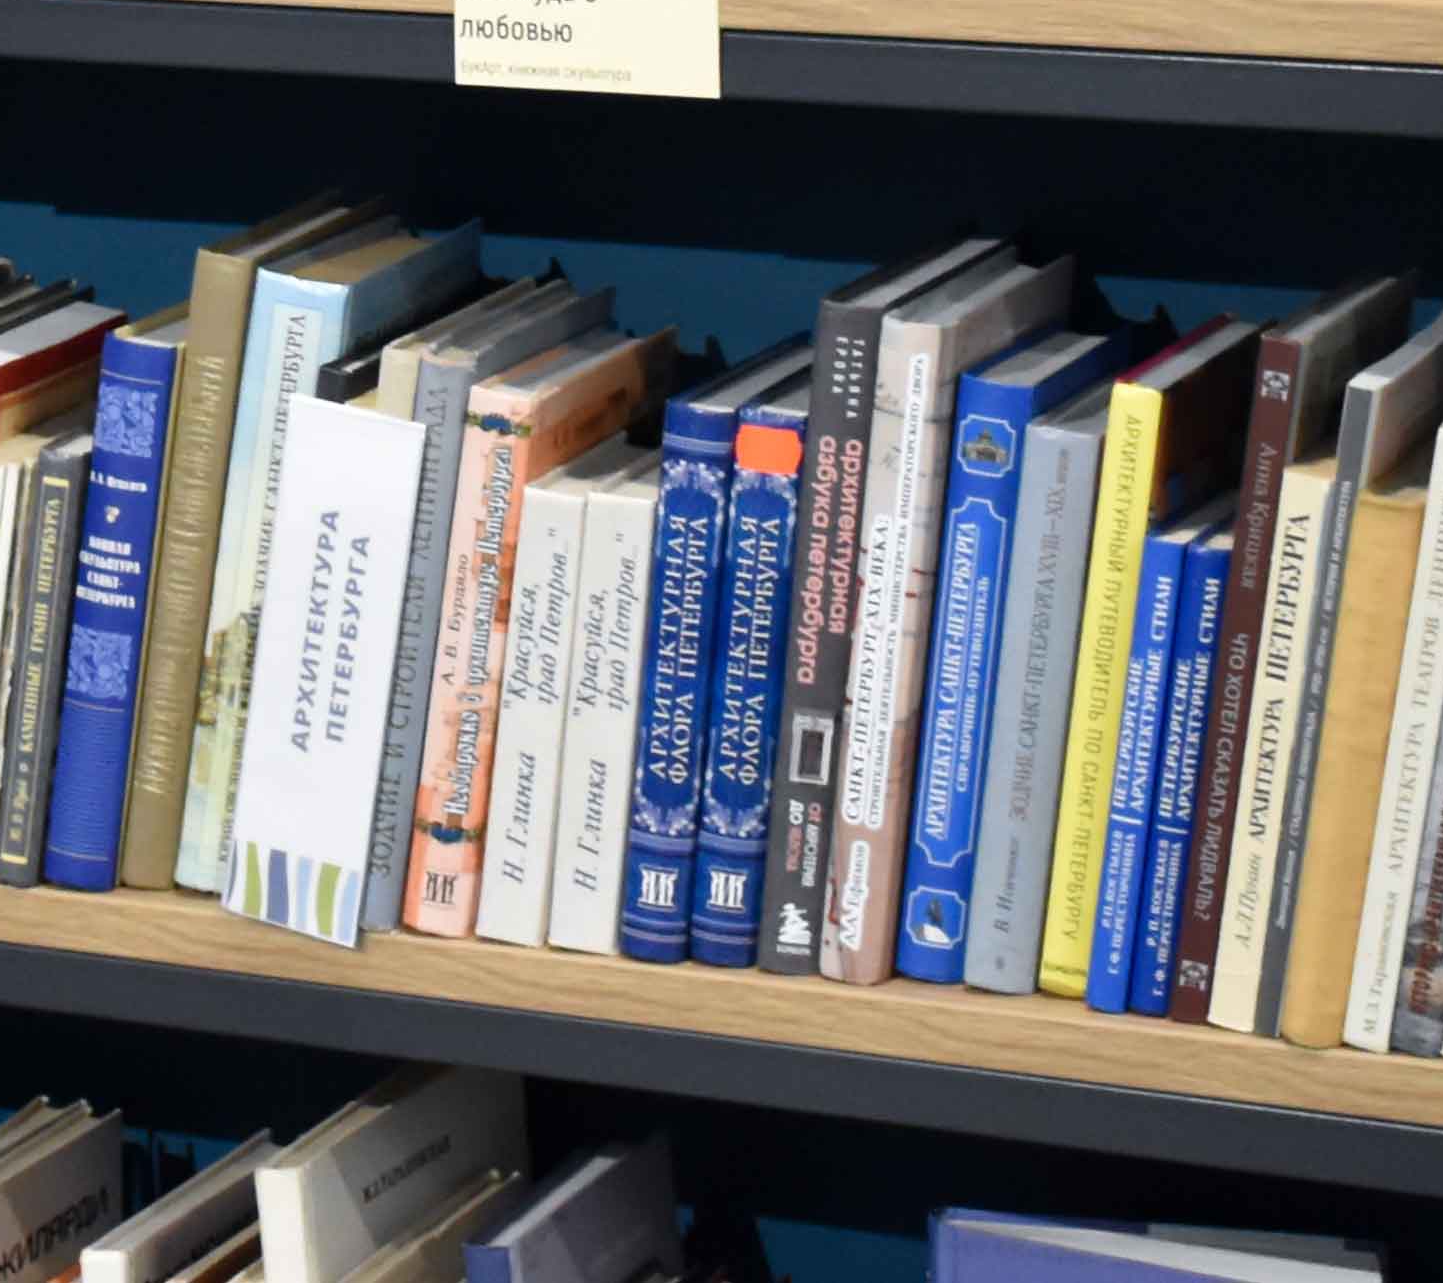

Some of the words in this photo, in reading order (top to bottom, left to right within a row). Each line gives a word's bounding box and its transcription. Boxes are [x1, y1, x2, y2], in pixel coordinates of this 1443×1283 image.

[460, 14, 574, 47] любовью
[812, 435, 838, 528] азбука
[828, 439, 862, 634] архитектурная
[1106, 415, 1142, 575] АРХИТЕКТУРНЫЙ
[290, 510, 339, 752] АРХИТЕКТУРА
[325, 535, 371, 742] ПЕТЕРБУРГА
[647, 515, 686, 779] АРХИТЕКТУРНАЯ
[675, 517, 708, 679] ПЕТЕРБУРГА
[718, 516, 758, 779] АРХИТЕКТУРНАЯ
[744, 518, 781, 680] ПЕТЕРБУРГА
[795, 539, 830, 684] петербурга
[937, 521, 976, 704] САНКТ-ПЕТЕРБУРГА
[1092, 580, 1124, 721] ПУТЕВОДИТЕЛЬ
[1227, 632, 1249, 669] ЧТО
[1264, 512, 1310, 682] ПЕТЕРБУРГА
[669, 693, 694, 784] ФЛОРА
[739, 694, 764, 785] ФЛОРА
[1086, 730, 1104, 754] ПО
[1112, 658, 1143, 808] ПЕТЕРБУРГСКИЕ
[1127, 649, 1164, 814] АРХИТЕКТУРНЫЕ
[1150, 576, 1173, 641] СТИЛИ
[1158, 658, 1191, 817] ПЕТЕРБУРГСКИЕ
[1175, 652, 1212, 822] АРХИТЕКТУРНЫЕ
[1198, 577, 1222, 644] СТИЛИ
[1218, 676, 1244, 733] ХОТЕЛ
[1247, 697, 1284, 843] АРХИТЕКТУРА
[927, 708, 956, 840] АРХИТЕКТУРА
[1061, 760, 1101, 941] САНКТ-ПЕТЕРБУРГУ
[1206, 738, 1237, 817] СКАЗАТЬ
[1191, 823, 1224, 923] ЛИДВАЛЬ?
